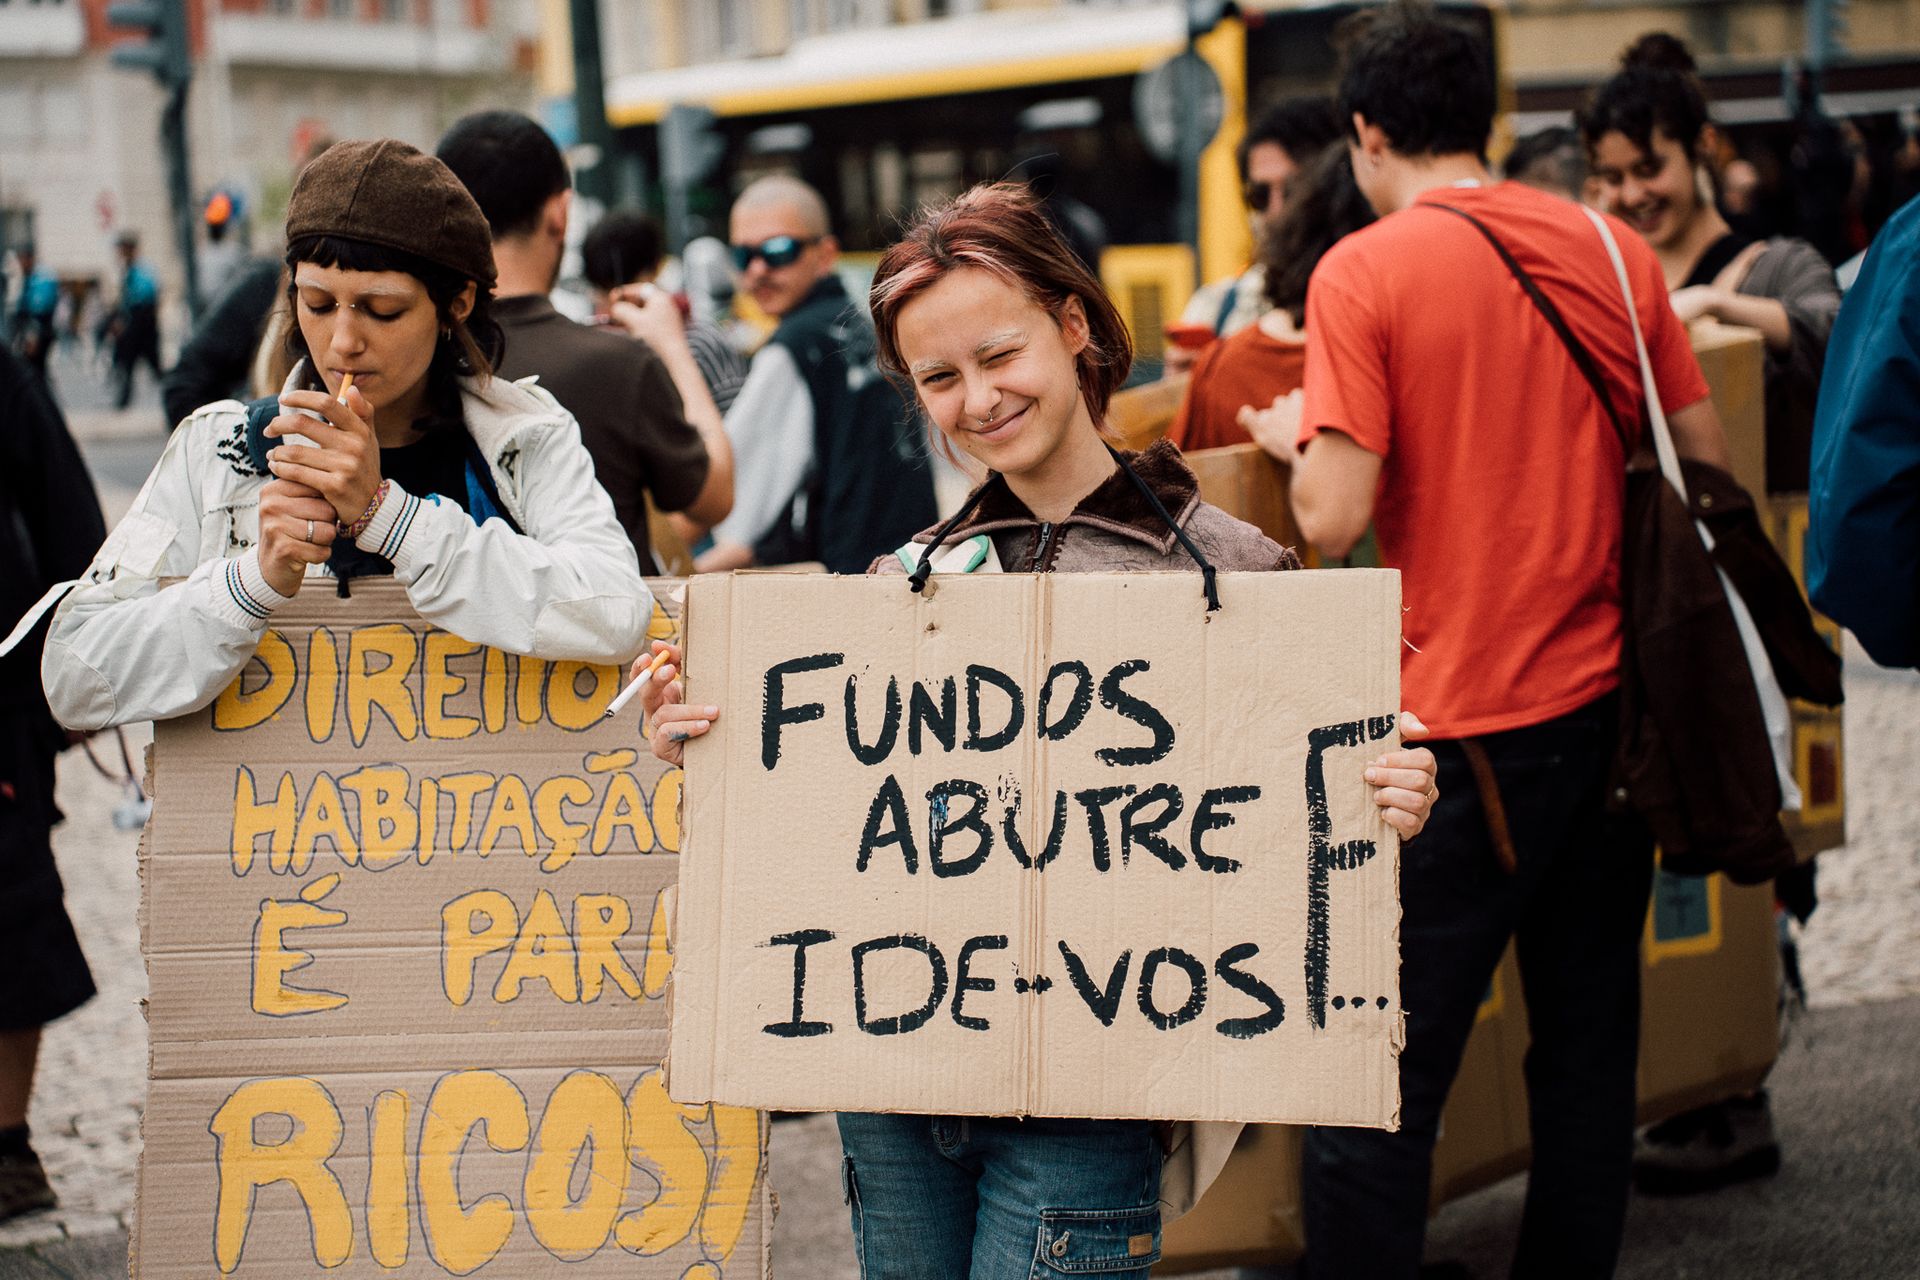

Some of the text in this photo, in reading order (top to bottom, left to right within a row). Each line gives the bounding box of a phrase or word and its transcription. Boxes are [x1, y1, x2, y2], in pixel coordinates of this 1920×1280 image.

[760, 652, 1175, 771] FUNDOS
[856, 773, 1261, 878] ABUTRE
[250, 872, 349, 1018] É
[755, 928, 1286, 1040] IDE-VOS
